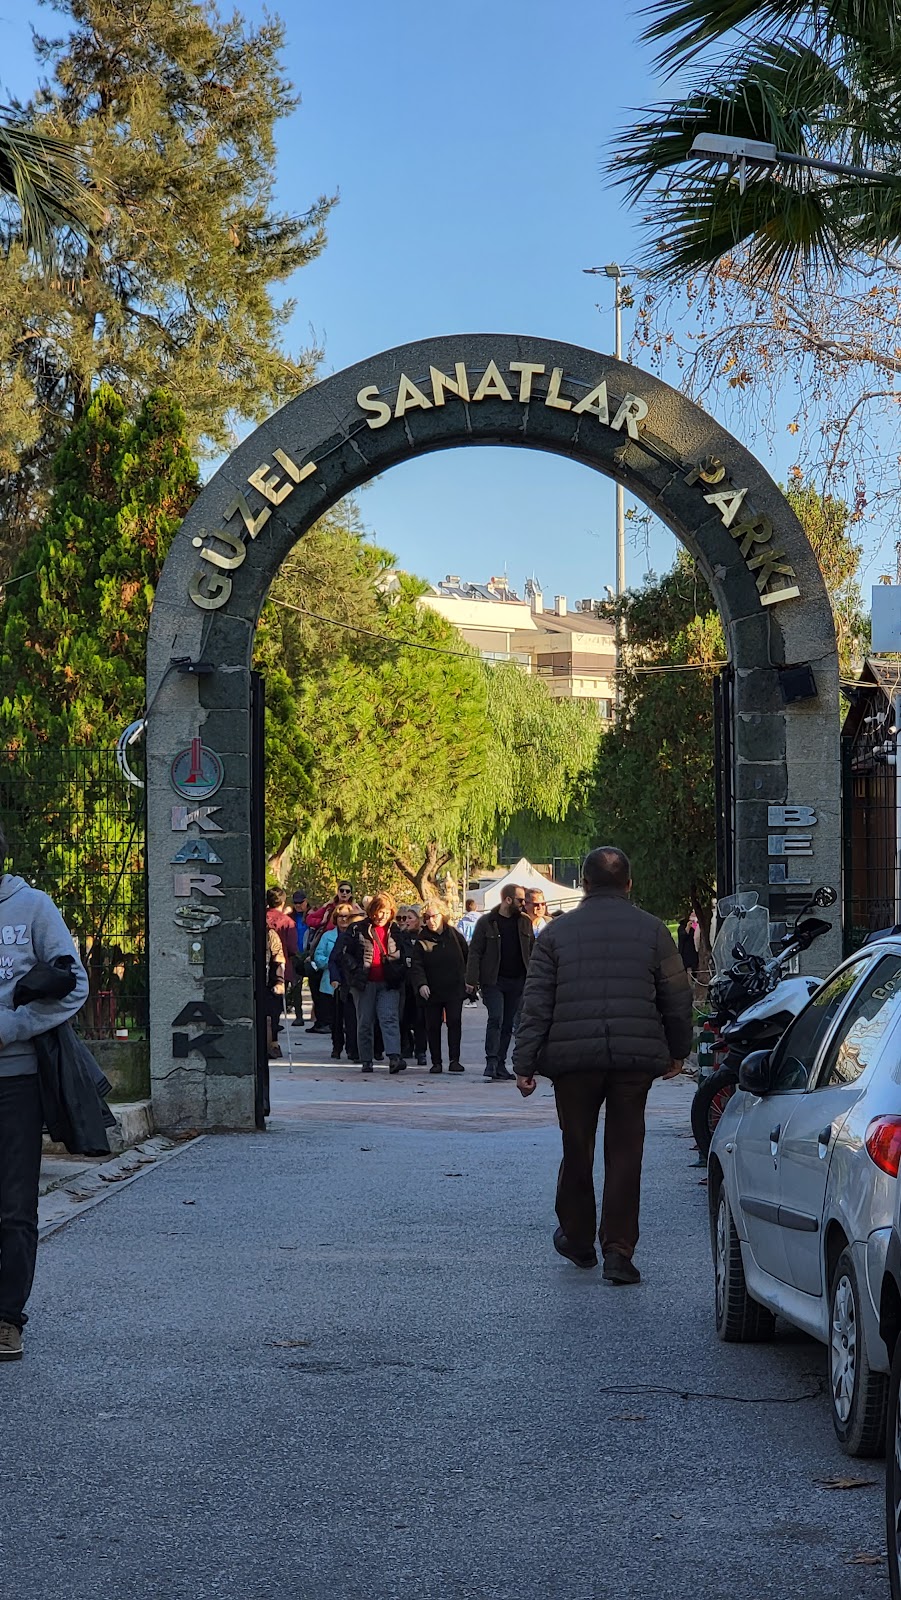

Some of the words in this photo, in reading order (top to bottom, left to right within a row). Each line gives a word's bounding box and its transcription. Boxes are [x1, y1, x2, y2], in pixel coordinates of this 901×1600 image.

[189, 448, 317, 609] GÜZEL
[356, 359, 649, 440] SANATLAR
[683, 454, 801, 606] PARKI
